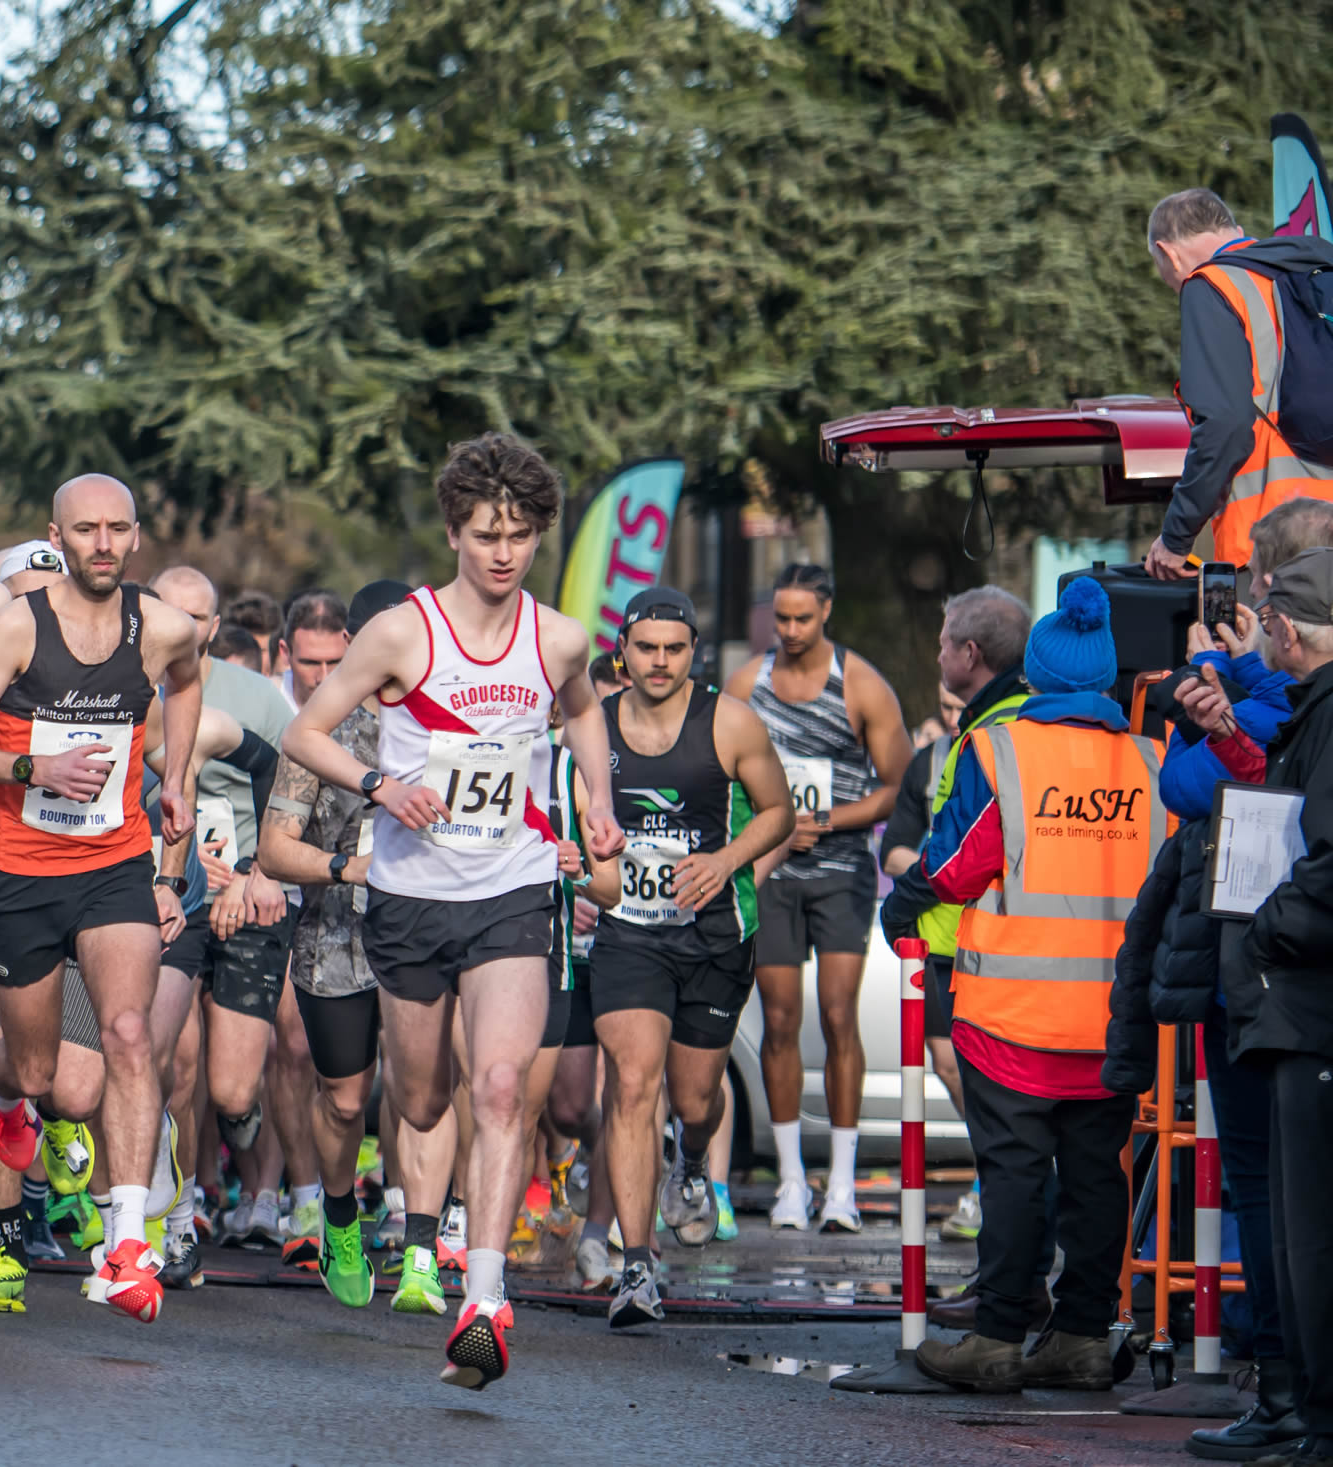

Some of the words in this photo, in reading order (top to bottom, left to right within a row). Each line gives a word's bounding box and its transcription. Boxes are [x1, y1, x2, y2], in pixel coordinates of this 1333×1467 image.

[127, 613, 138, 646] soar
[55, 690, 121, 708] Marshall
[450, 685, 539, 711] GLOUCESTER
[36, 707, 72, 721] Milton
[75, 711, 115, 722] Keynes
[465, 706, 502, 717] Athletic
[506, 705, 527, 718] Club
[445, 768, 514, 816] 154
[1034, 786, 1144, 823] LuSH
[40, 809, 87, 825] BOURTON
[90, 814, 107, 825] 10K
[643, 814, 667, 829] CLC
[432, 822, 483, 836] BOURTON
[1036, 826, 1063, 837] race
[1067, 825, 1139, 841] timing.co.uk
[623, 861, 679, 901] 368
[621, 905, 660, 920] BOURTON
[662, 908, 678, 919] 10K
